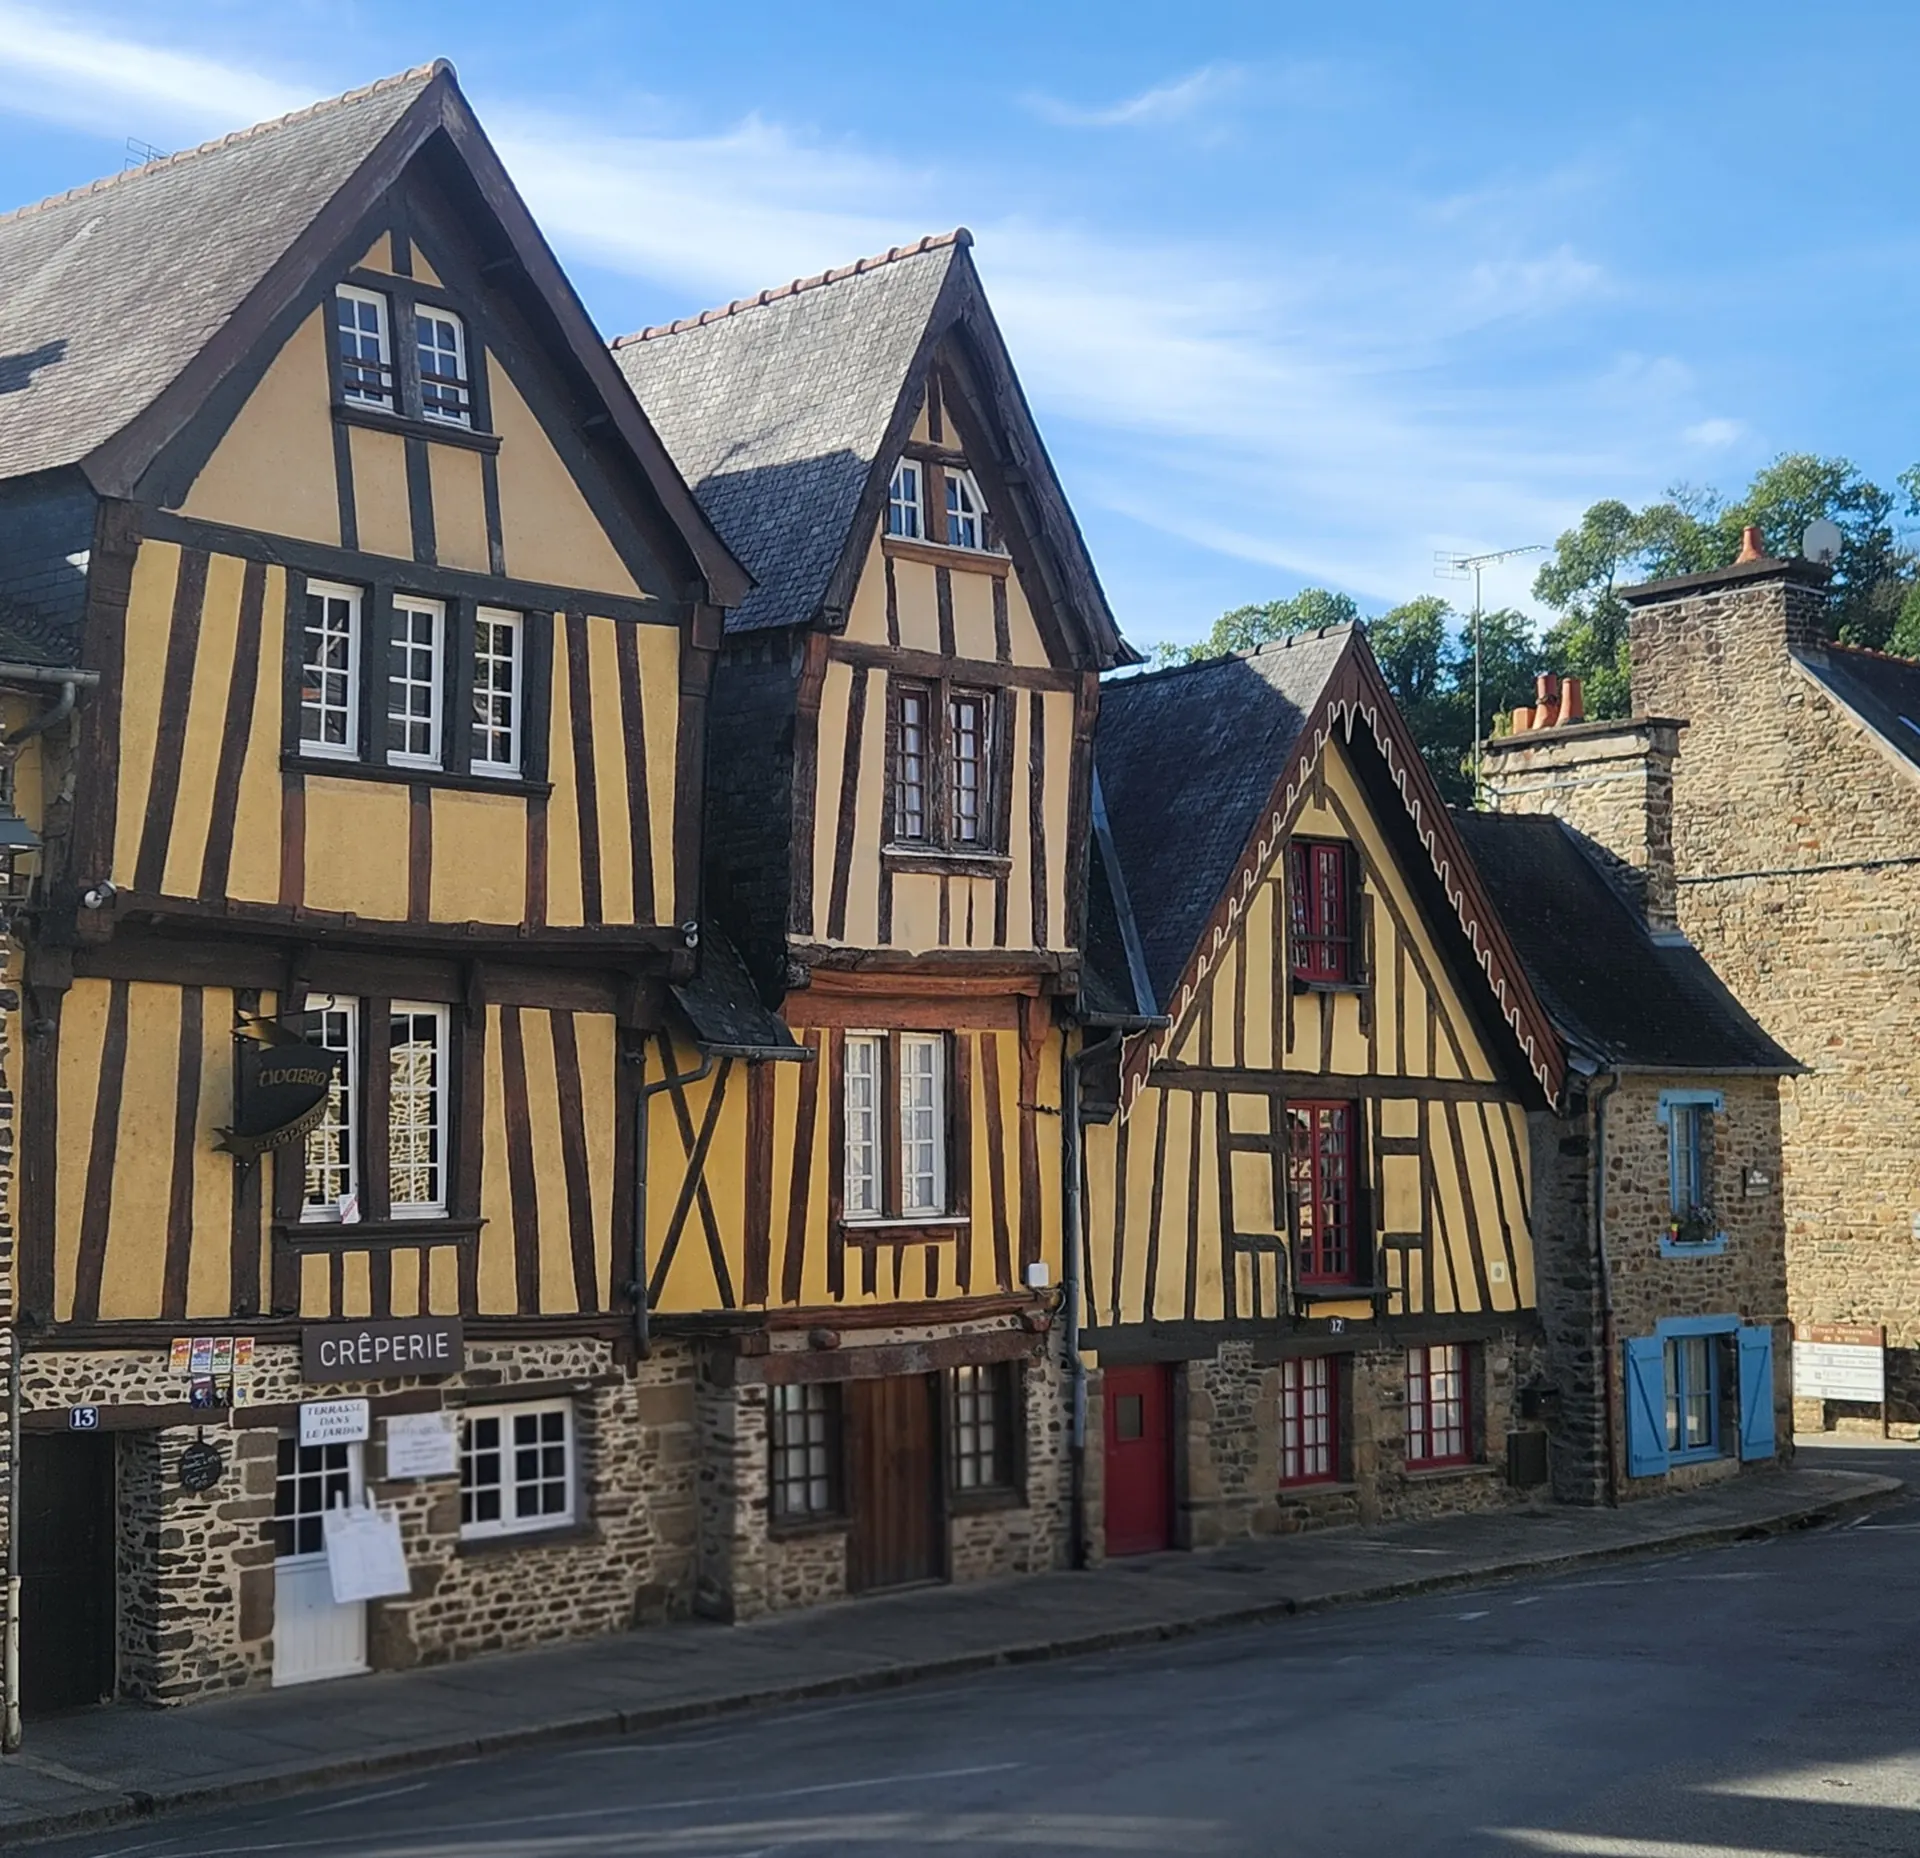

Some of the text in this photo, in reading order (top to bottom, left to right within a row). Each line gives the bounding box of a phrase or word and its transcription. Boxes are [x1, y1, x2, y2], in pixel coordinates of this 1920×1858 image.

[1332, 1319, 1343, 1332] 17
[320, 1332, 449, 1367] CRÊPERIE
[307, 1403, 363, 1416] TERRASSE
[74, 1408, 95, 1427] 13
[320, 1415, 350, 1426] DANS
[305, 1425, 363, 1439] LE JARDIN
